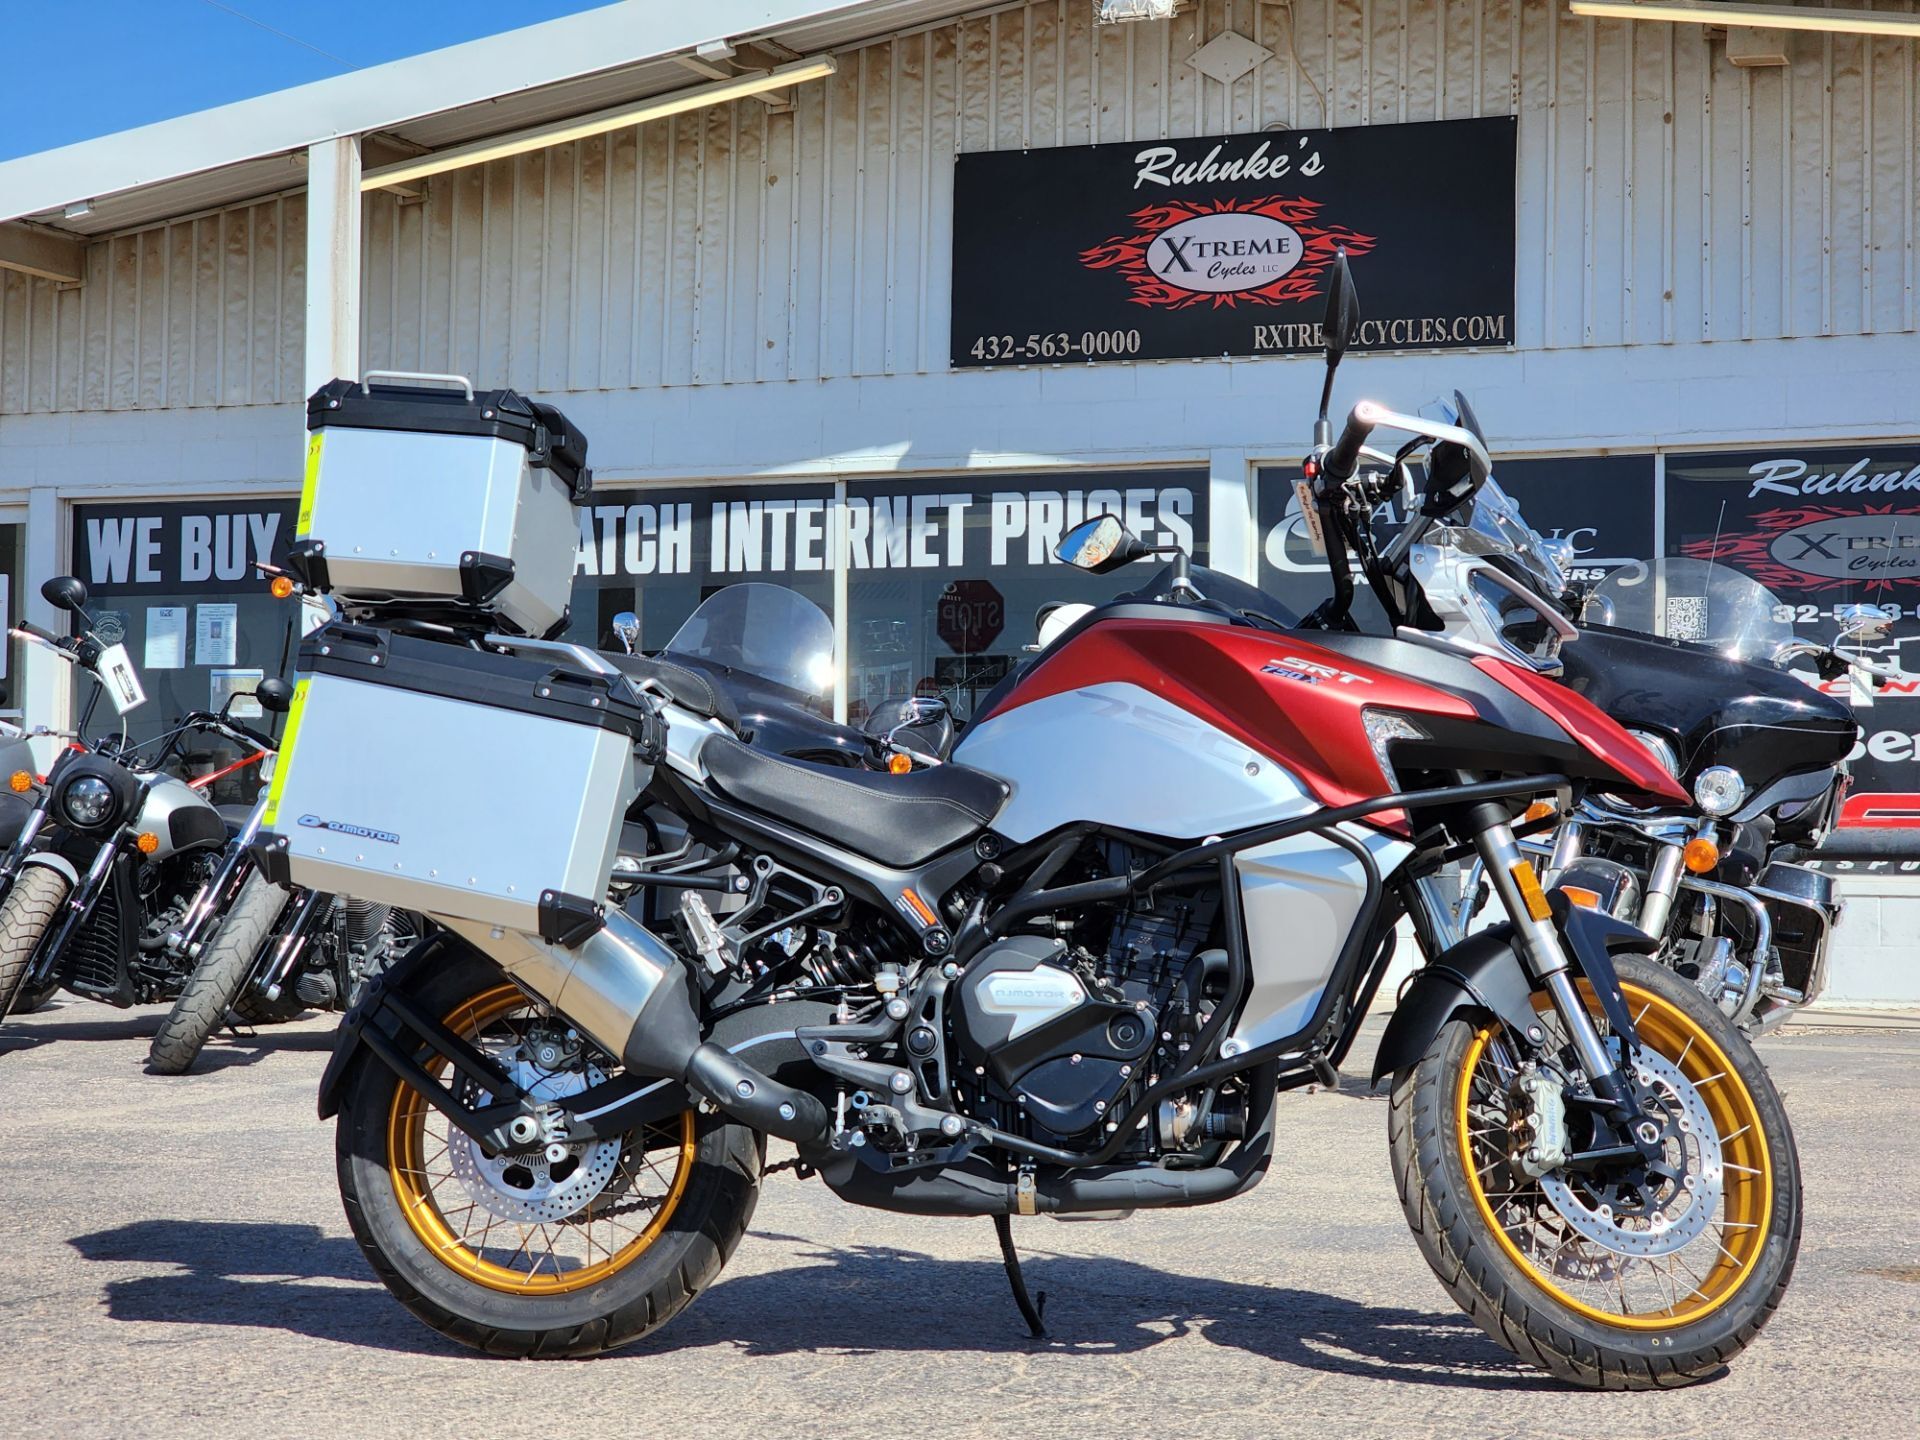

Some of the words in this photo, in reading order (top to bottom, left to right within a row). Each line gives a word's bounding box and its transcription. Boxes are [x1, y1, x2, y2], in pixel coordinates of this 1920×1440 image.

[1134, 136, 1325, 189] Ruhnke's
[1158, 235, 1291, 274] XTREME
[1207, 261, 1257, 280] Cycles
[1262, 264, 1279, 273] LLC
[970, 329, 1141, 360] 432-563-0000
[1253, 315, 1507, 349] RXTREECYCLES.COM
[87, 517, 163, 584] WE
[180, 513, 281, 582] BUY
[573, 503, 692, 576] ATCH
[711, 493, 973, 573] INTERNET
[1847, 555, 1918, 572] Cycles
[1269, 656, 1374, 685] SRT
[327, 820, 400, 845] QJMOTOR
